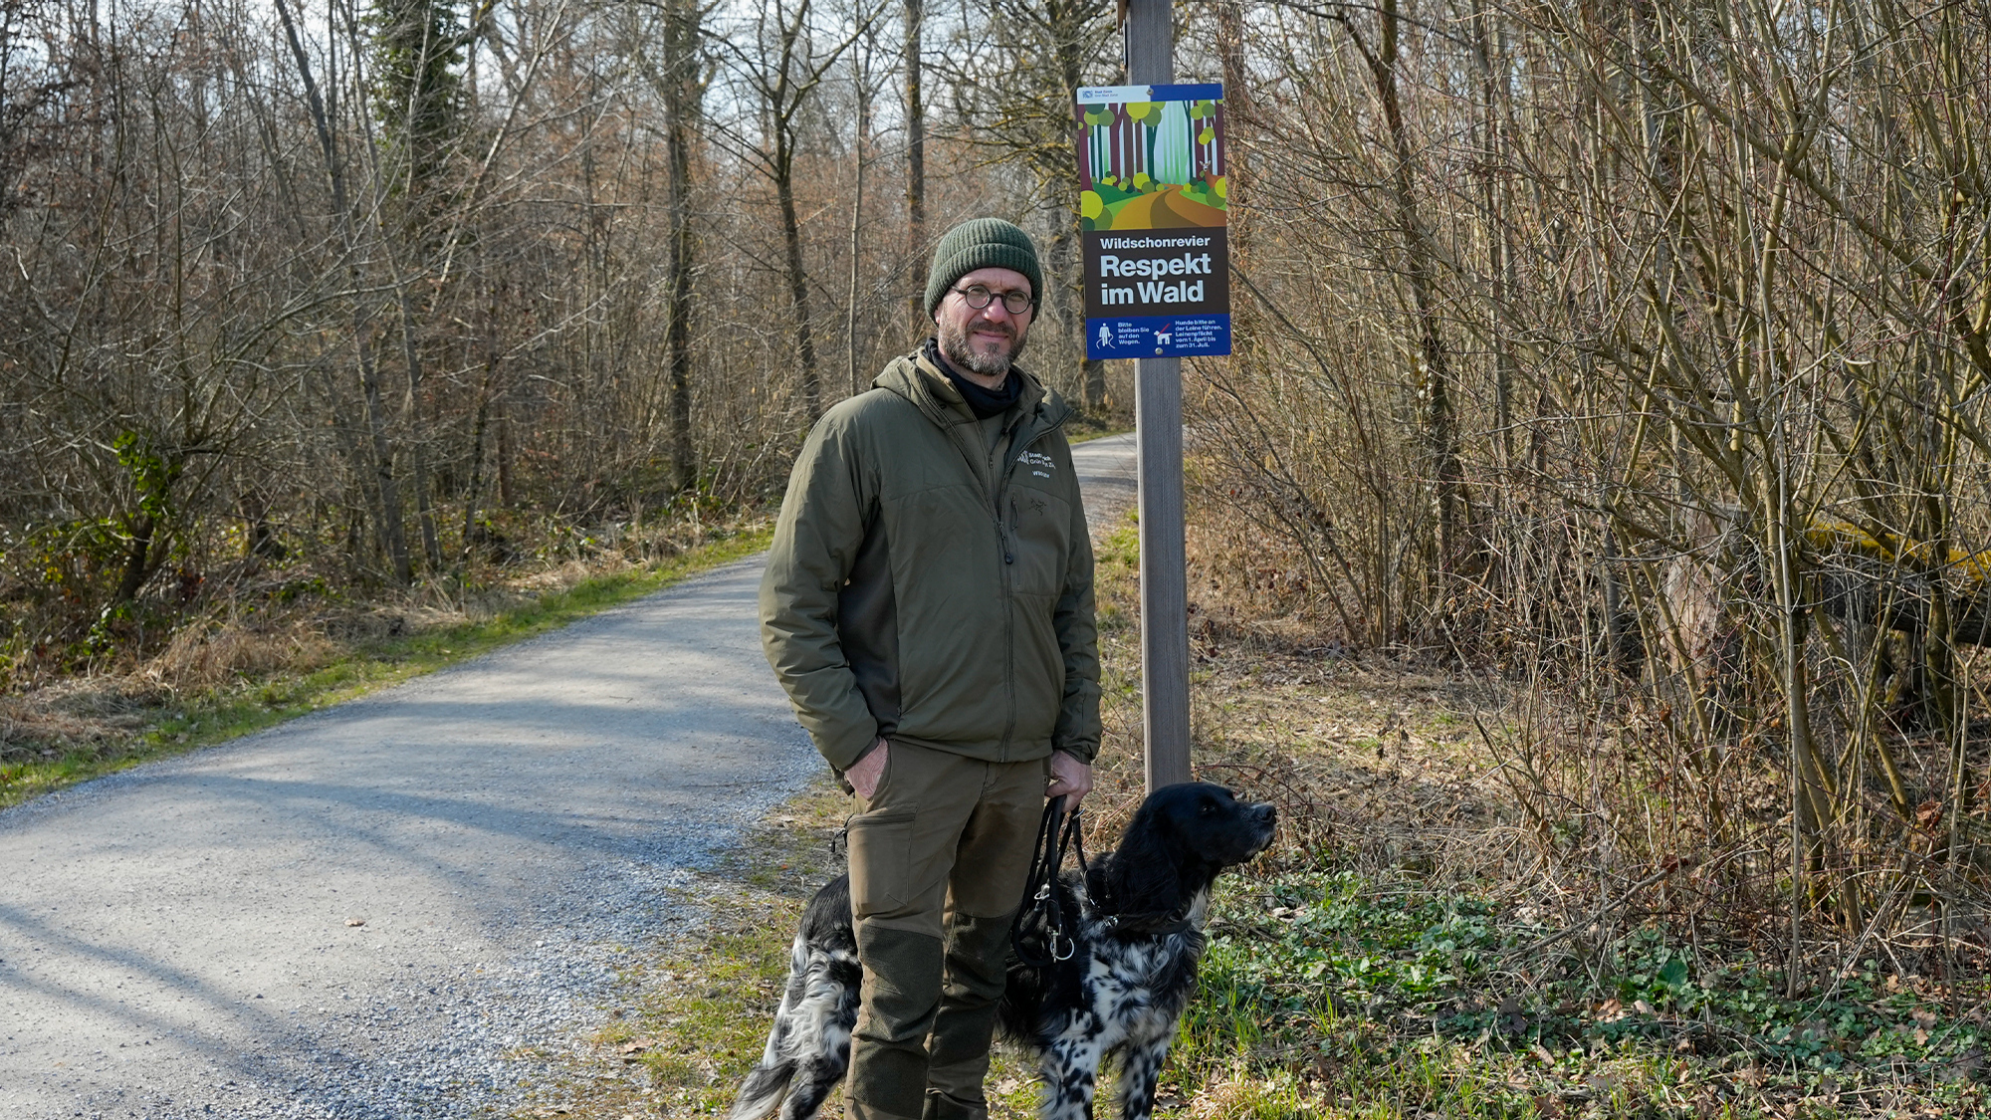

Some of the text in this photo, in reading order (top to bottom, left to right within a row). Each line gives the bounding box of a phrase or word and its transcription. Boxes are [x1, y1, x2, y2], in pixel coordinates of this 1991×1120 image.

[1100, 235, 1211, 249] Wildschonrevier
[1100, 252, 1212, 281] Respekt
[1101, 280, 1204, 305] im Wald
